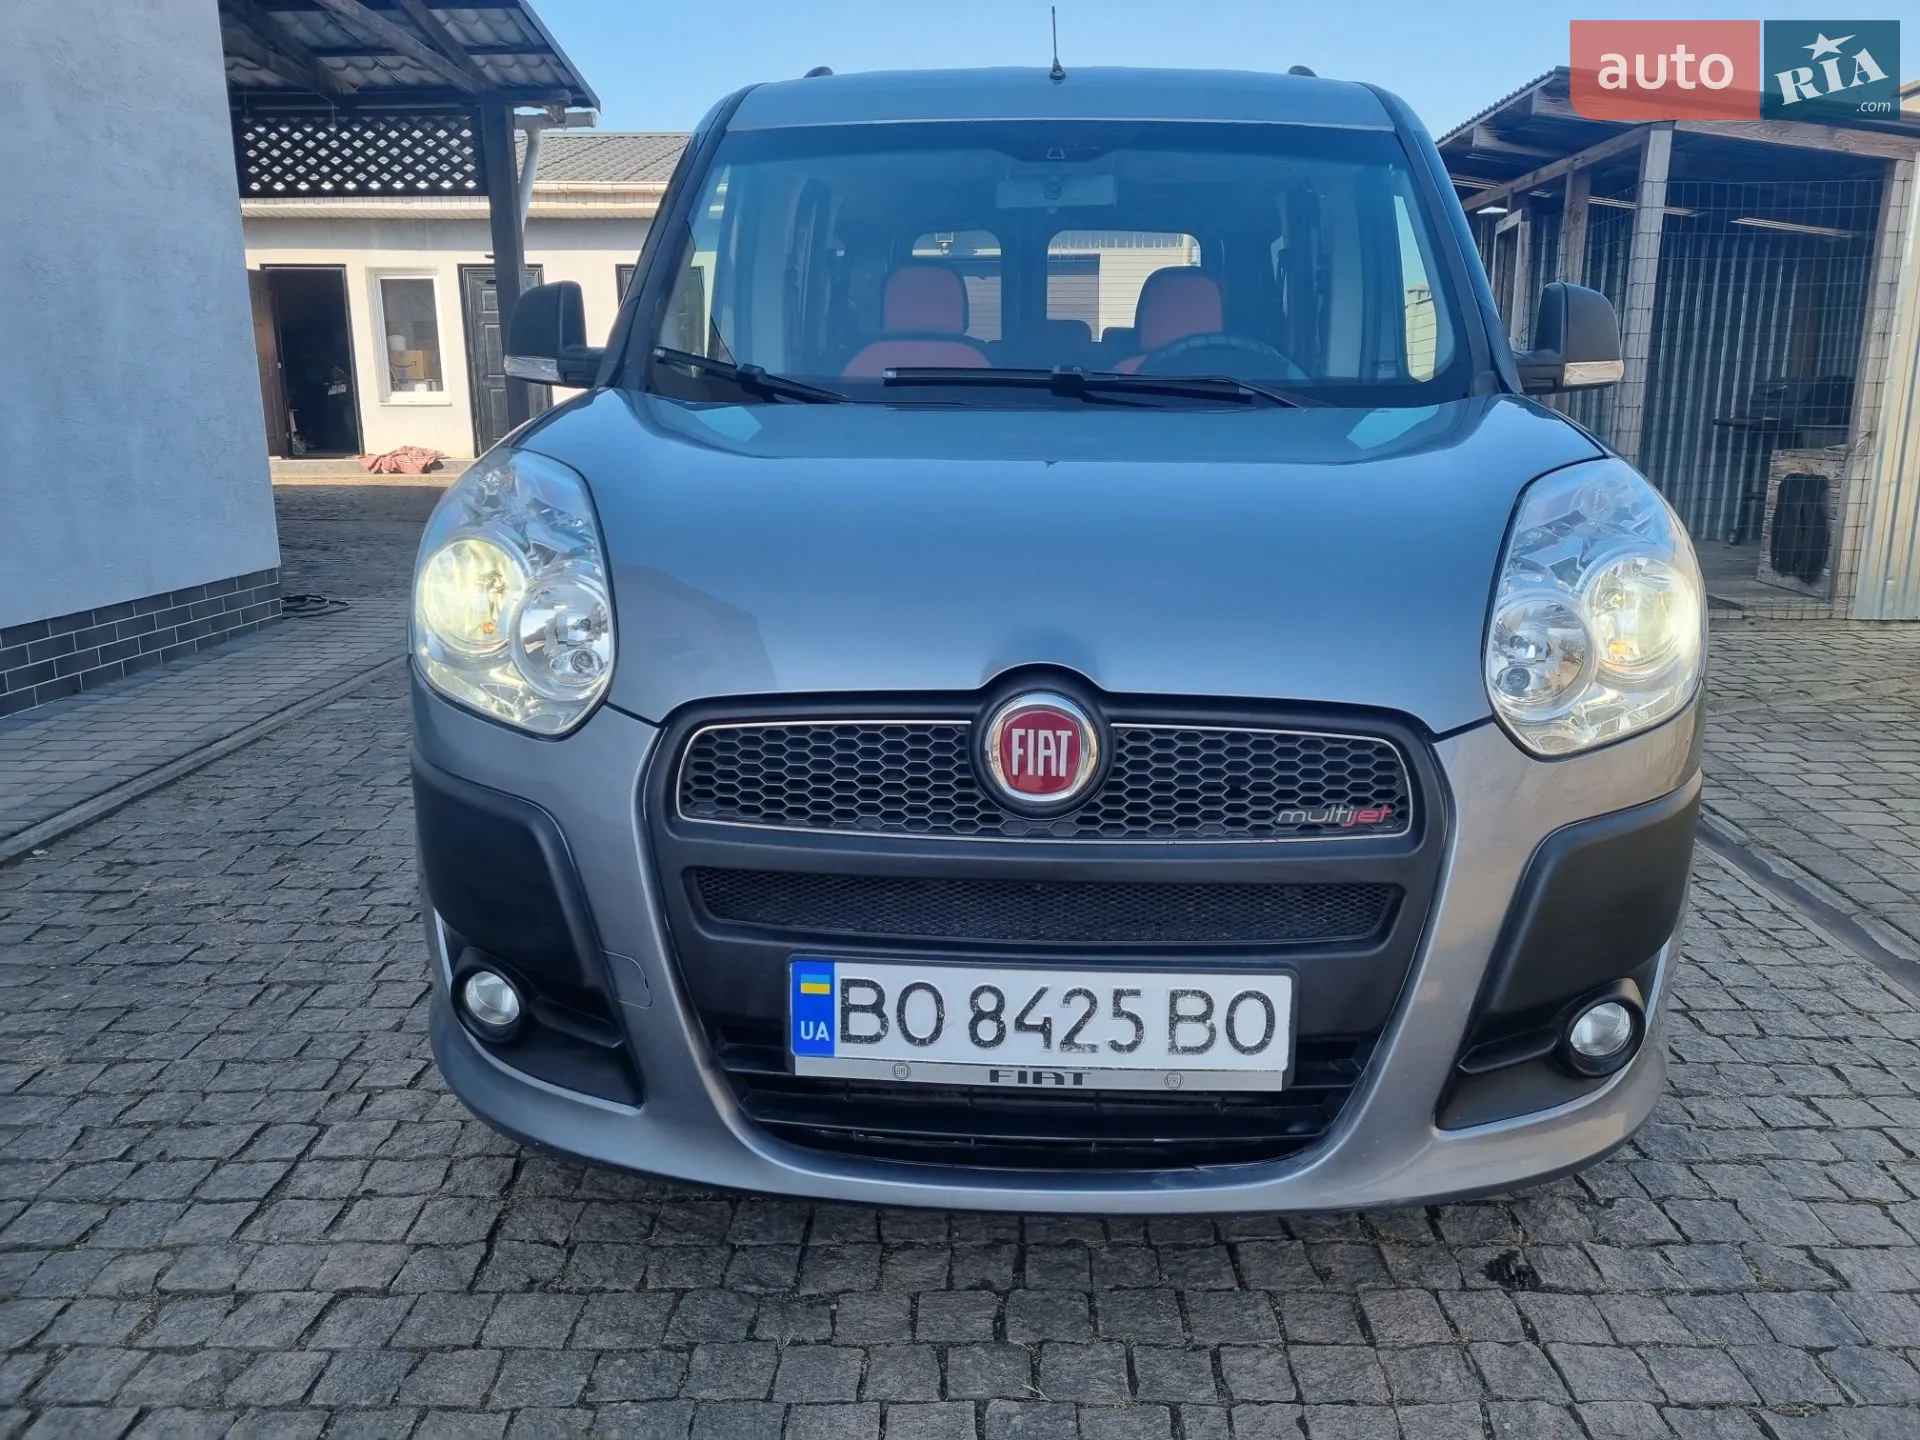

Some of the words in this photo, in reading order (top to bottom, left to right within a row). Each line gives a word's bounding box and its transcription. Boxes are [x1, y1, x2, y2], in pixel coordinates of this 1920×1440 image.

[1011, 728, 1073, 777] FIAT
[1277, 803, 1393, 828] multijet
[839, 977, 946, 1048] BO
[967, 983, 1145, 1055] 8425
[1168, 988, 1276, 1056] BO
[801, 1020, 831, 1042] UA
[989, 1069, 1092, 1086] FIAT
